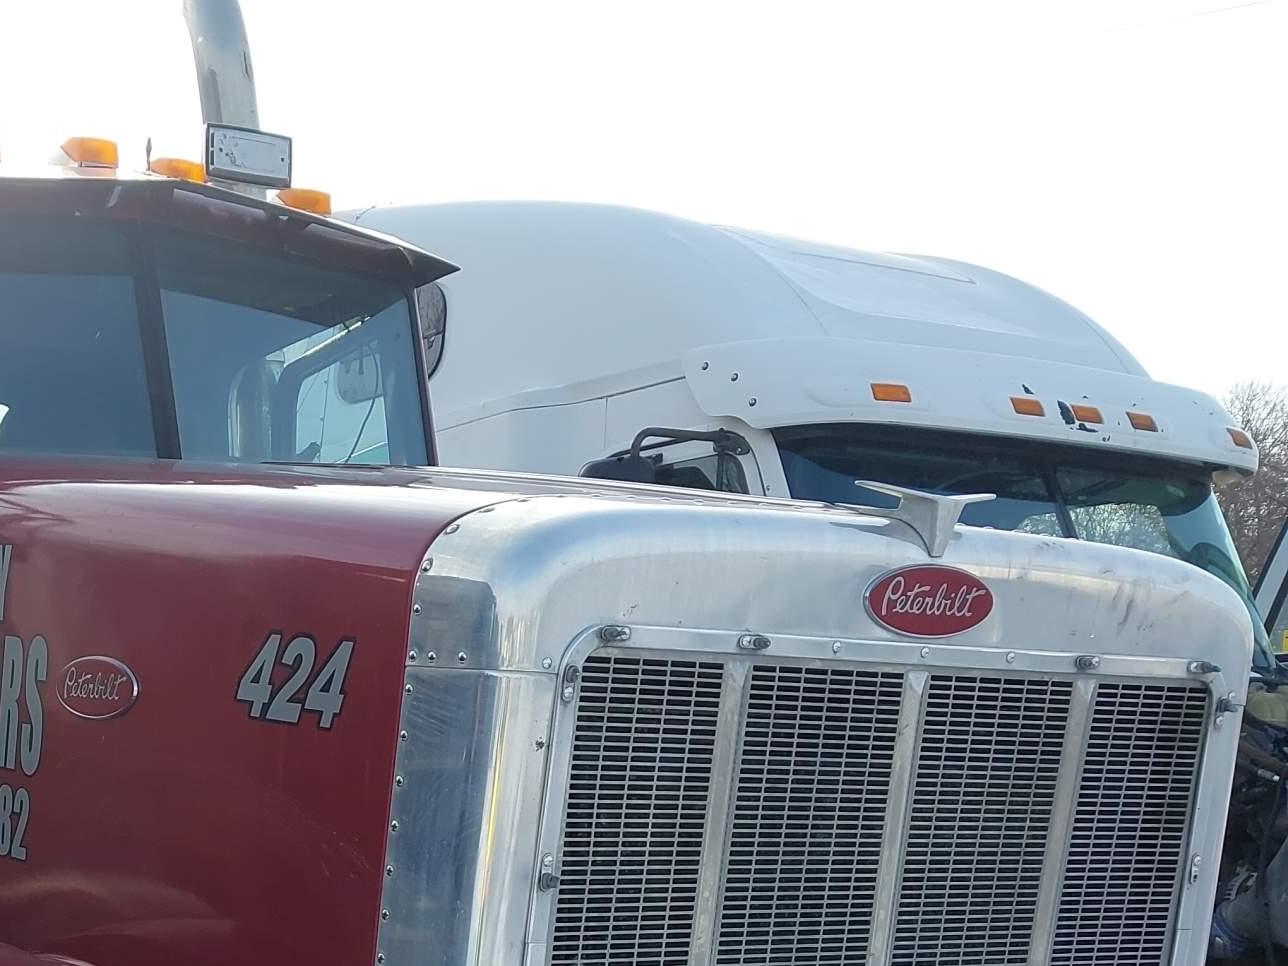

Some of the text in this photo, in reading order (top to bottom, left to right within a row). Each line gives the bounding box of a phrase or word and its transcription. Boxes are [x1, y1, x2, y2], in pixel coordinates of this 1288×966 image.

[880, 575, 988, 618] Peterbilt
[62, 665, 128, 701] Peterbilt
[235, 632, 356, 730] 424
